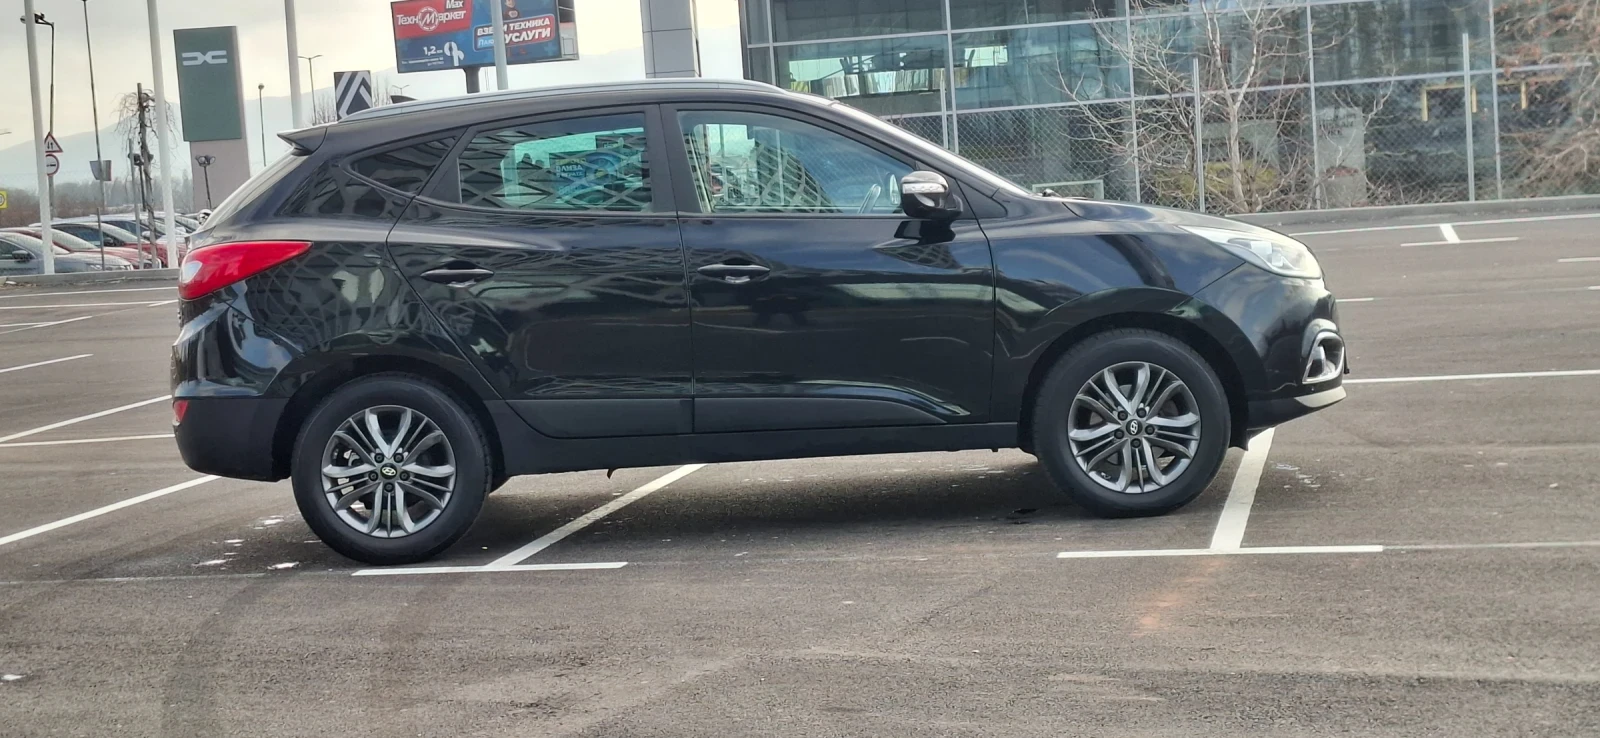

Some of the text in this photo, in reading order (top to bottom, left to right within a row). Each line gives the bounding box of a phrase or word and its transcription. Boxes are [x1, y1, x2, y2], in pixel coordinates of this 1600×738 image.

[446, 0, 463, 9] Max
[509, 17, 550, 31] ТЕХНИКА
[504, 28, 551, 43] УСЛУГИ
